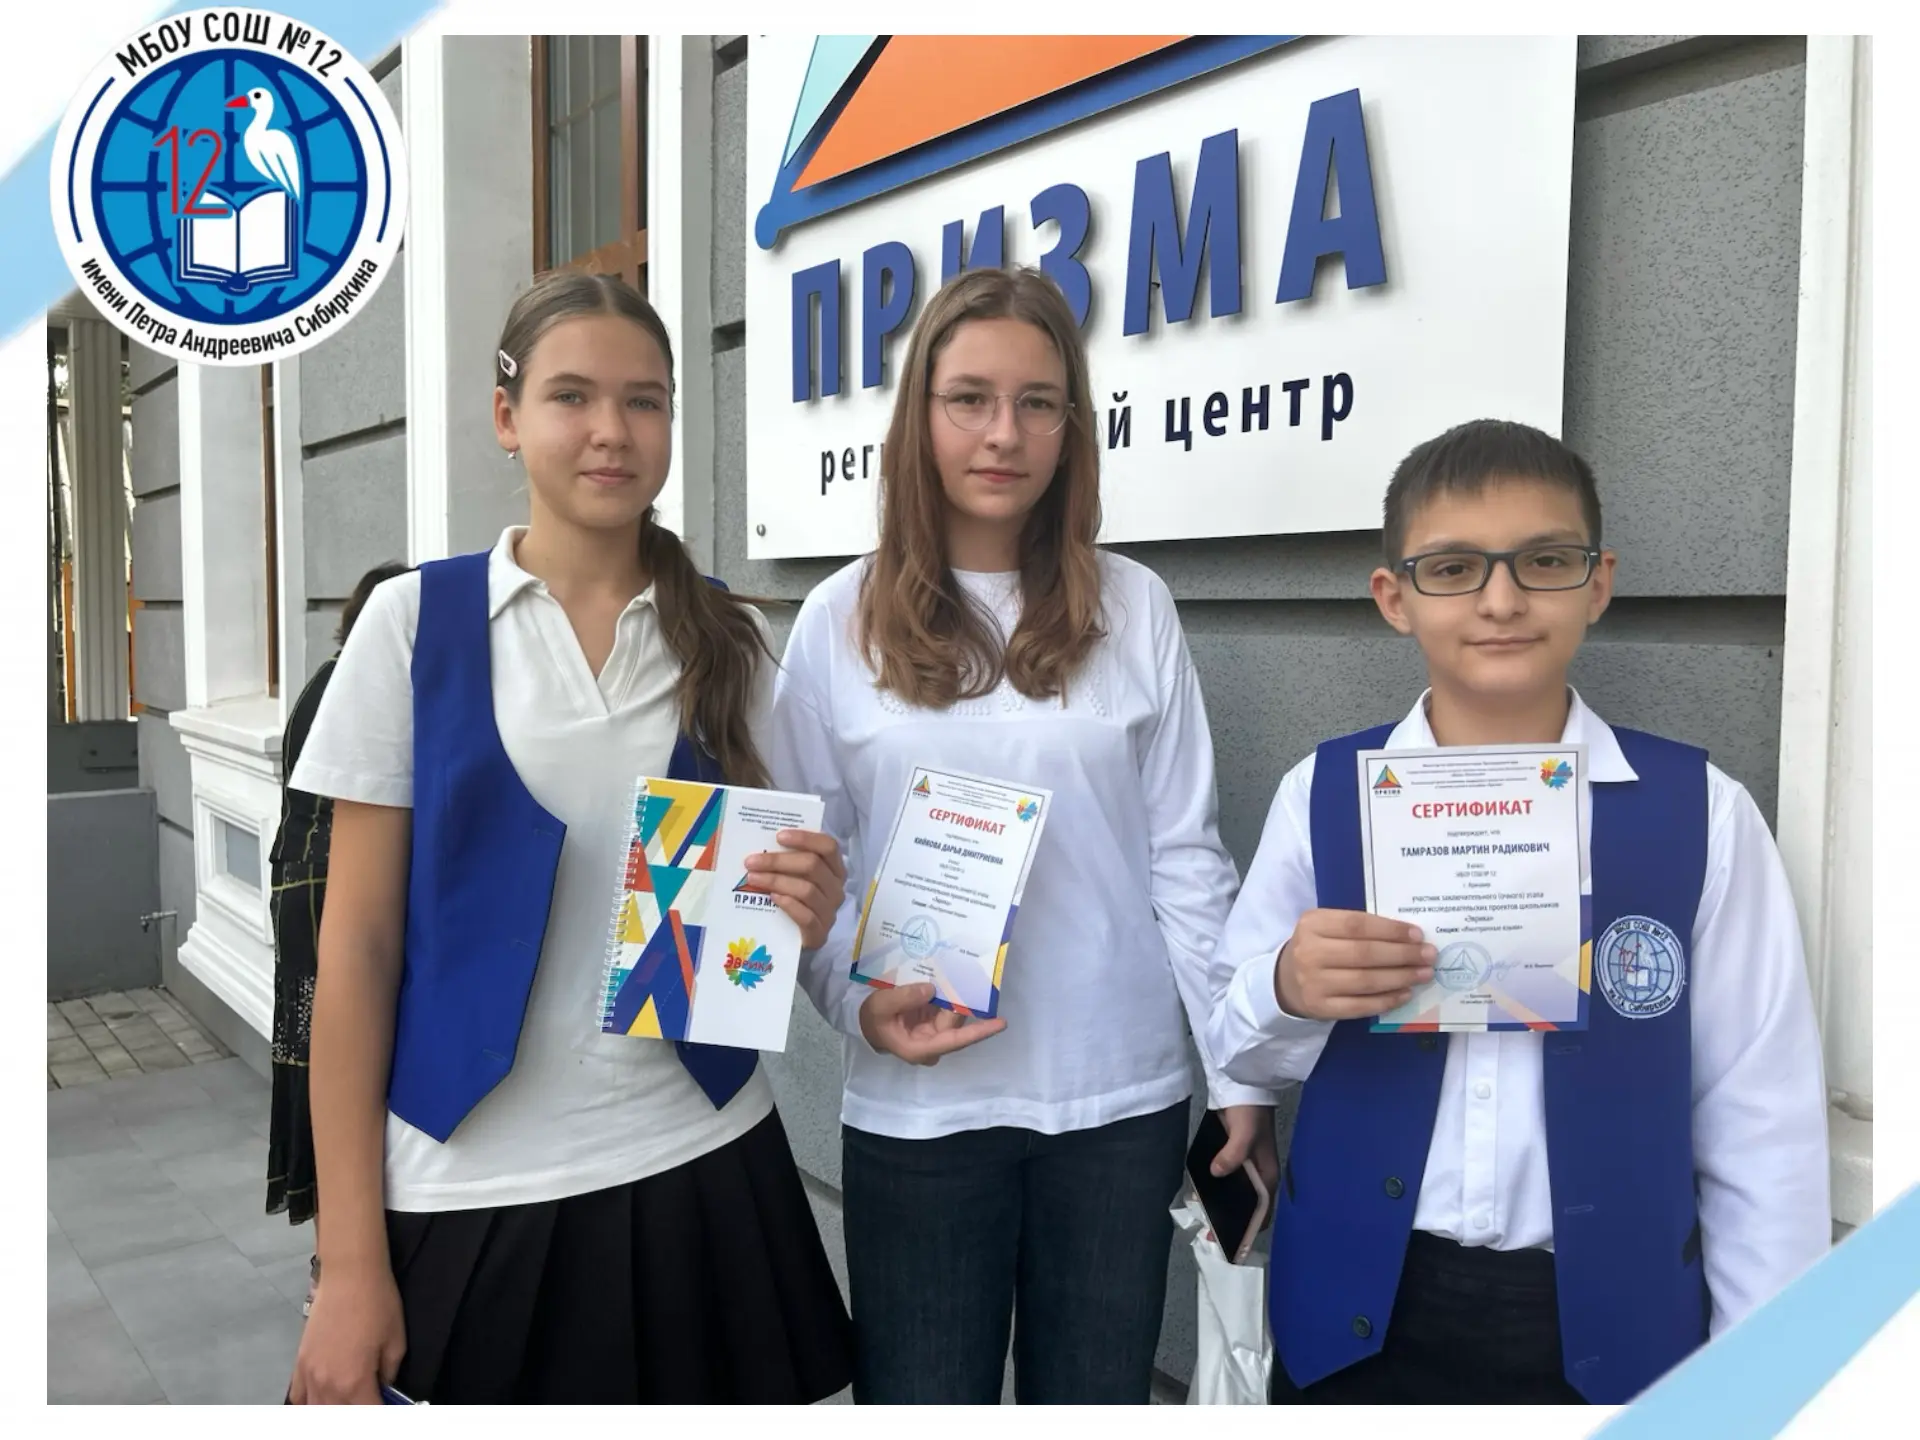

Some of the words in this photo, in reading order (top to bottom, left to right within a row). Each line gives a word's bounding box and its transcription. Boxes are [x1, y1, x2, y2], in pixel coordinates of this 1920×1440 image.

[1164, 371, 1355, 452] центр
[1411, 799, 1534, 819] СЕРТИФИКАТ
[928, 807, 1007, 836] СЕРТИФИКАТ
[941, 843, 962, 857] ДАРЬЯ
[961, 848, 1004, 866] ДМИТРИЕВНА
[1400, 846, 1450, 858] ТАМРАЗОВ
[1451, 844, 1490, 856] МАРТИН
[1492, 842, 1551, 855] РАДИКОВИЧ
